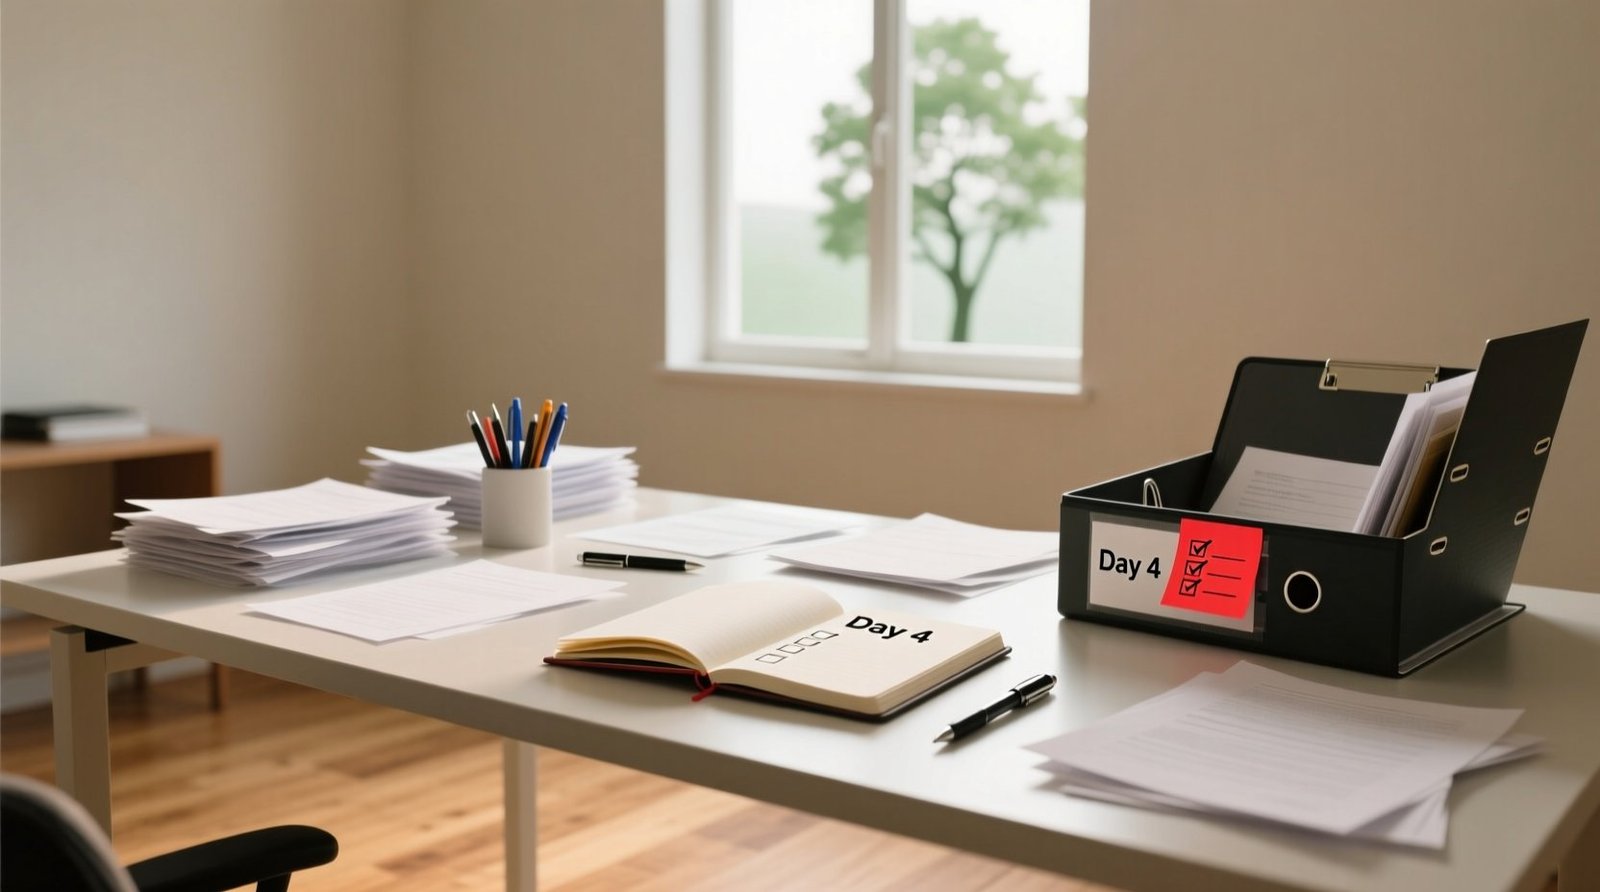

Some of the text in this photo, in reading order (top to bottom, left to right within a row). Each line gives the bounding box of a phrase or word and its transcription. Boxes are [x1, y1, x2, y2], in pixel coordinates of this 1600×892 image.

[1099, 548, 1161, 580] Day 4
[845, 615, 934, 643] Day 4
